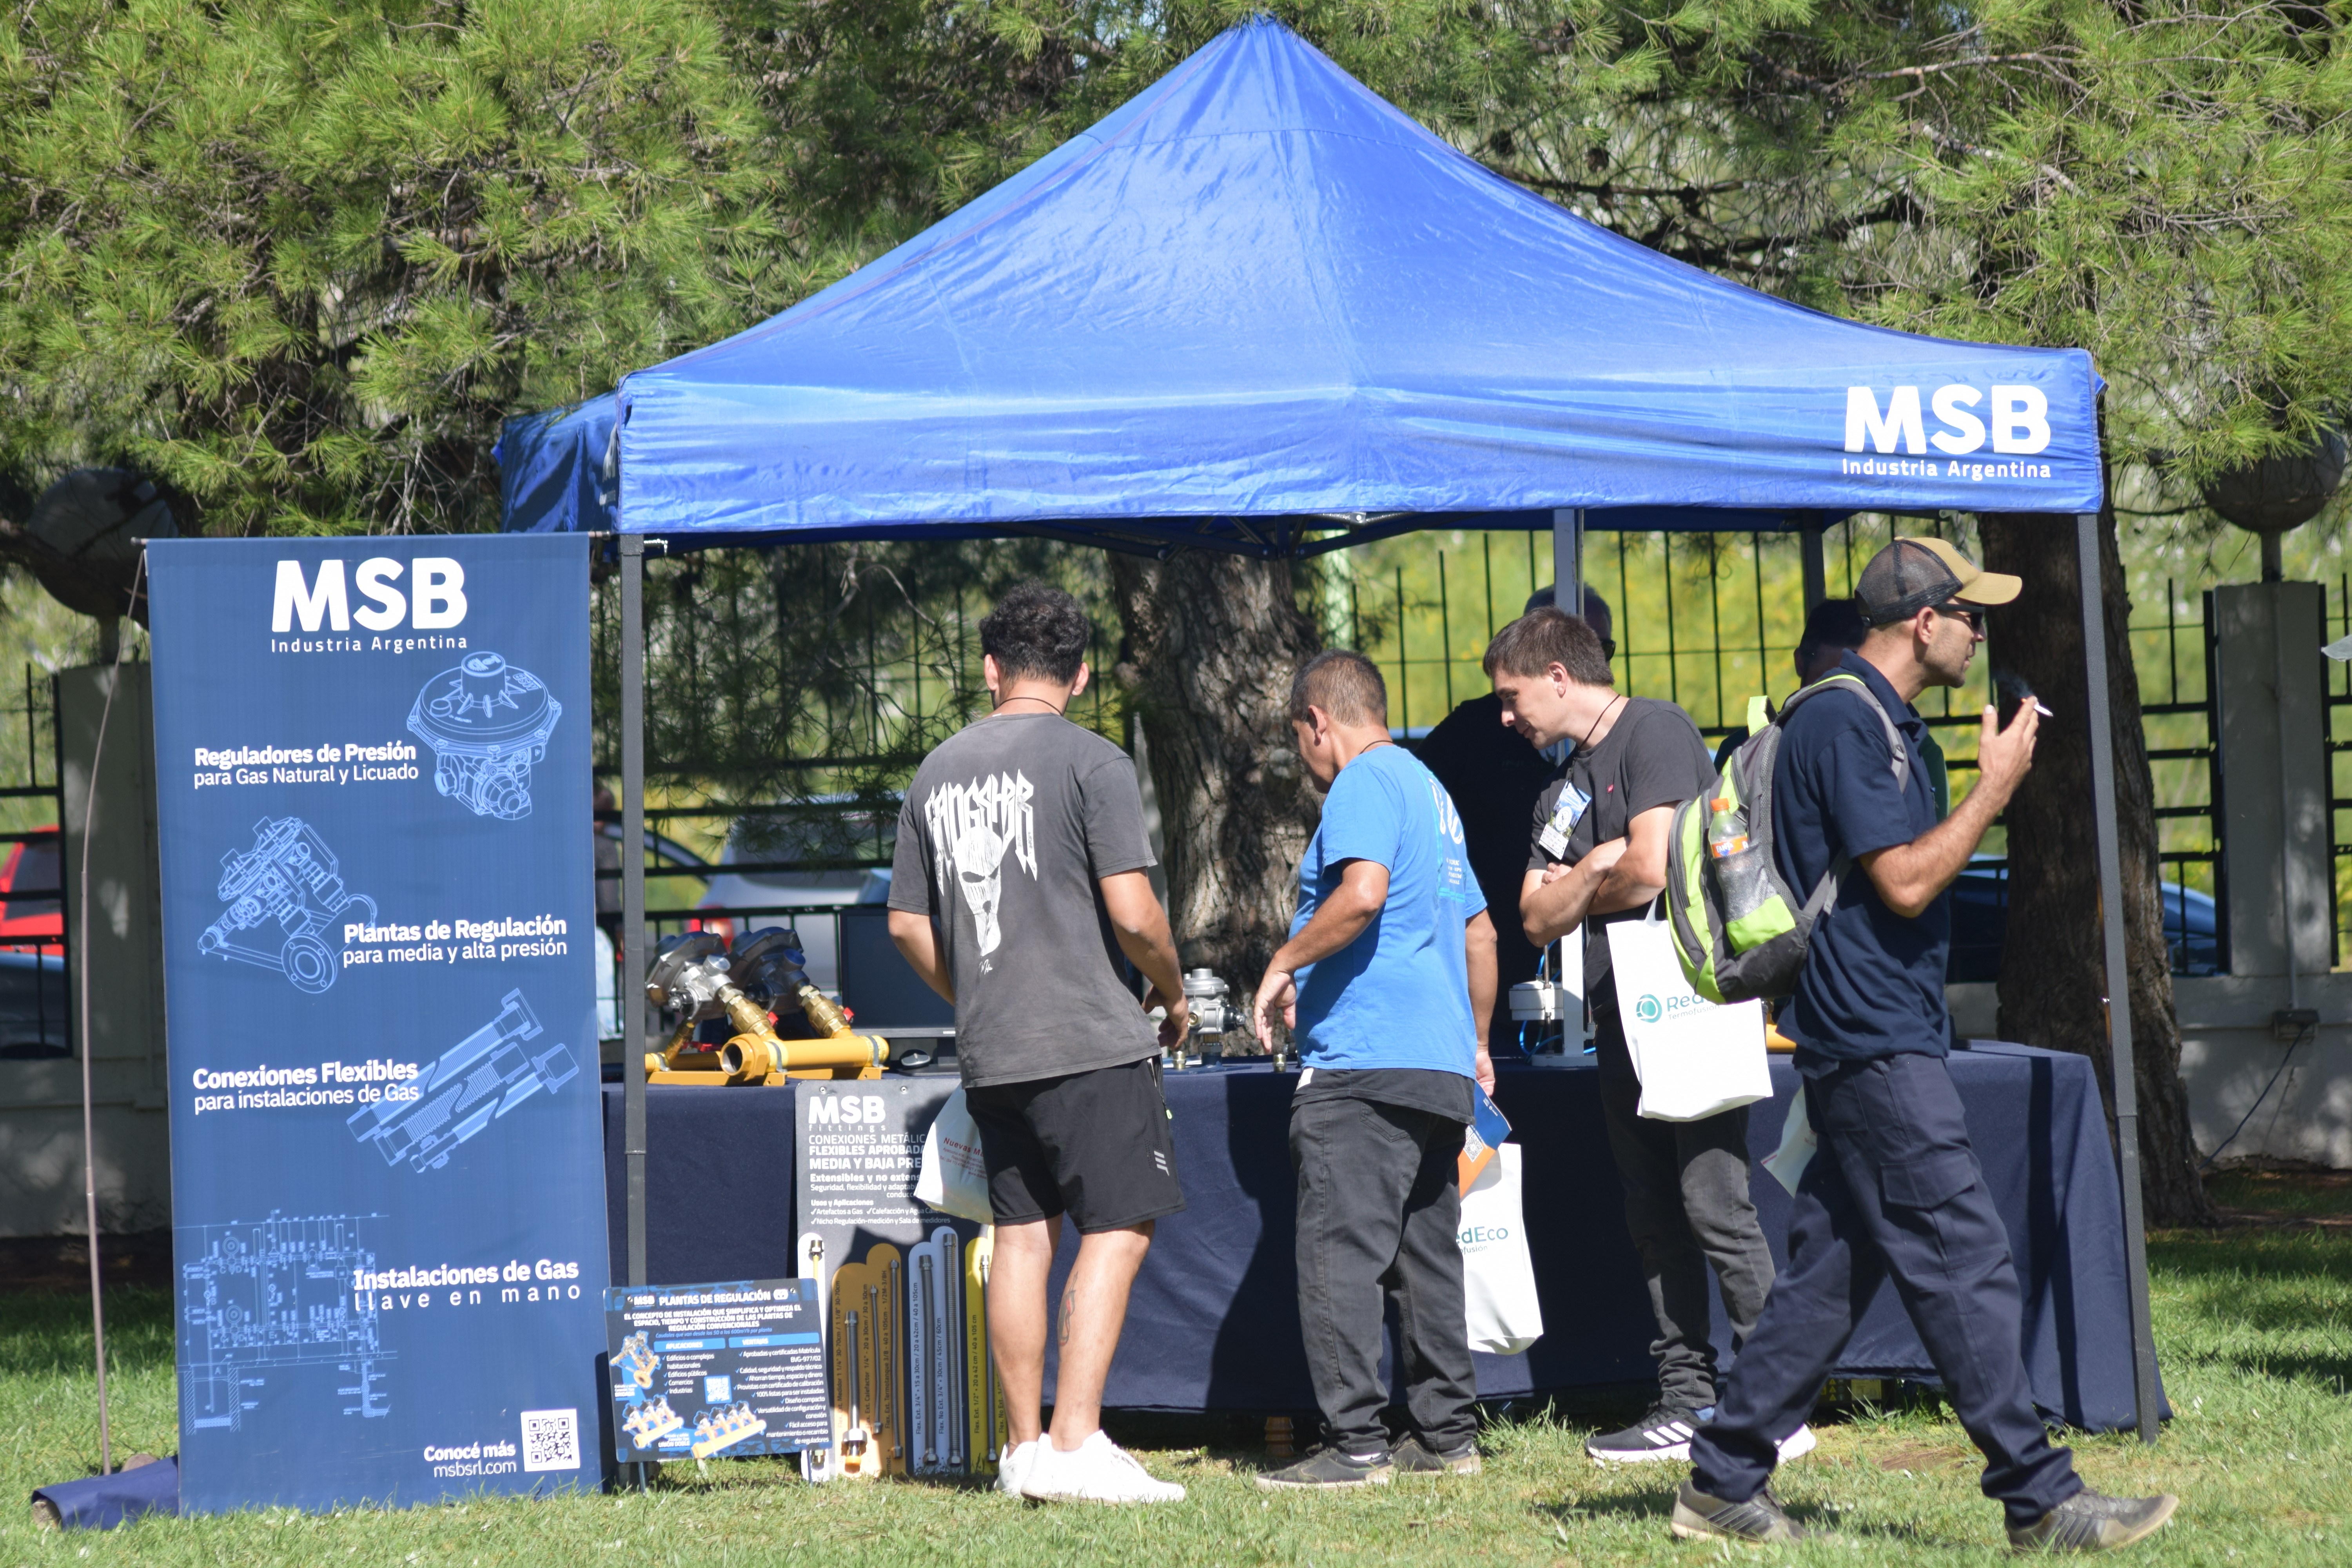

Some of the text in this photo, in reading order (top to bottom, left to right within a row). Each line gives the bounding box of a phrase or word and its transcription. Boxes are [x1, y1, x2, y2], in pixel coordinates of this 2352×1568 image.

[1844, 384, 2051, 454] MSB
[1842, 458, 2051, 481] Industria Argentina
[271, 557, 467, 633] MSB
[271, 634, 467, 654] Industria Argentina
[195, 740, 416, 770] Reguladores de Presión
[194, 763, 418, 789] para Gas Natural y Licuado
[1716, 842, 1734, 853] FANTA
[344, 914, 567, 944] Plantas de Regulación
[343, 937, 567, 968] para media y alta presión
[1668, 1004, 1720, 1020] Termofusión
[193, 1059, 418, 1090] Conexiones Flexibles
[194, 1083, 419, 1115] para instalaciones de Gas
[808, 1096, 886, 1124] MSB
[809, 1124, 886, 1132] fittings
[809, 1134, 877, 1144] CONEXIONES
[944, 1137, 971, 1152] Nuevas
[809, 1145, 865, 1156] FLEXIBLES
[809, 1158, 851, 1169] MEDIA
[853, 1158, 862, 1169] Y
[865, 1158, 895, 1169] BAJA
[810, 1173, 865, 1182] Extensibles
[867, 1175, 873, 1183] y
[810, 1184, 846, 1192] Seguridad,
[834, 1217, 895, 1225] Regulación-medición
[353, 1259, 579, 1290] Instalaciones de Gas
[355, 1284, 581, 1311] llave en mano
[634, 1289, 771, 1306] MSB PLANTAS DE REGULACIÓN
[632, 1312, 664, 1320] CONCEPTO
[673, 1307, 711, 1318] INSTALACIÓN
[726, 1307, 759, 1315] SIMPLIFICA
[764, 1305, 793, 1313] OPTIMIZA
[634, 1318, 661, 1327] ESPACIO,
[690, 1314, 735, 1324] CONSTRUCCIÓN
[972, 1314, 976, 1323] cm
[668, 1320, 760, 1332] REGULACIÓN CONVENCIONALES
[743, 1350, 768, 1358] Aprobadas
[973, 1356, 977, 1365] cm
[424, 1439, 516, 1461] Conocé más
[434, 1458, 517, 1478] msbsrl.com
